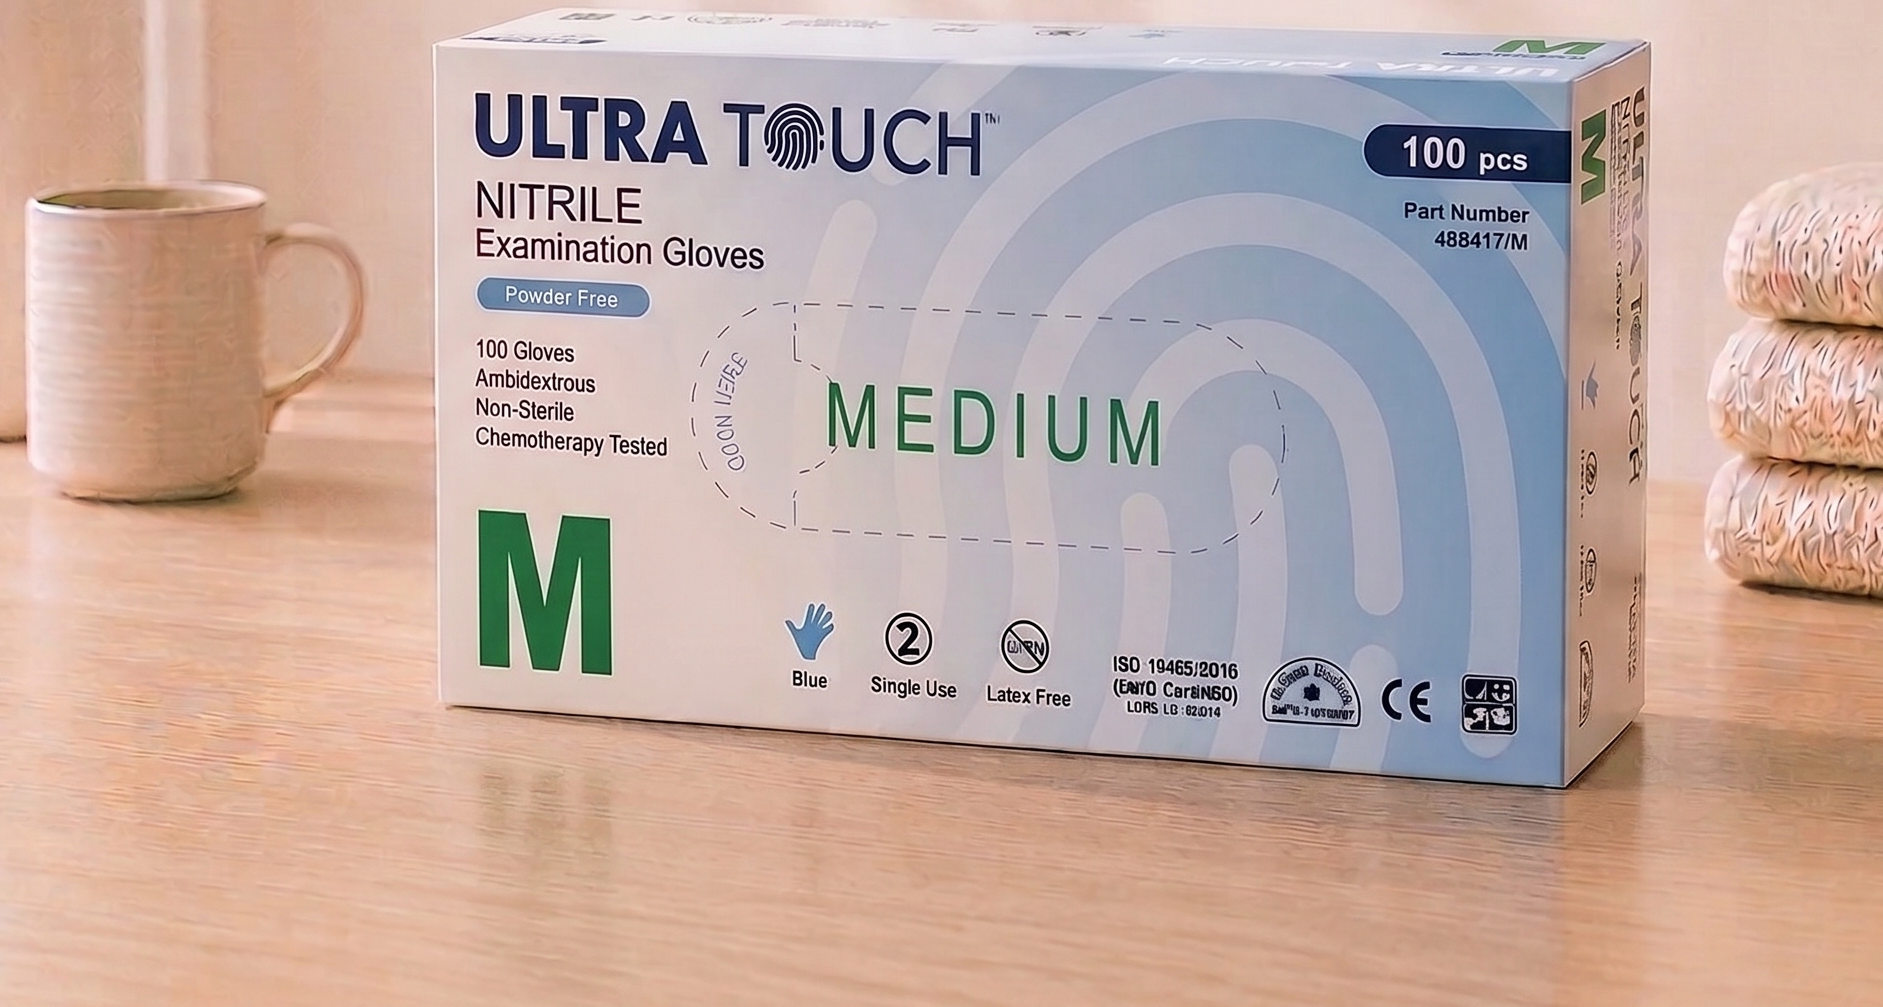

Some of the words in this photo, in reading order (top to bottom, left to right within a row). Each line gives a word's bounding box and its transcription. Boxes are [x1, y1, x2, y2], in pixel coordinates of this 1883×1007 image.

[475, 93, 708, 166] ULTRA
[723, 103, 981, 176] TOUCH
[1403, 136, 1466, 169] 100
[1479, 152, 1528, 175] pcs
[1581, 109, 1607, 205] M
[475, 181, 642, 224] NITRILE
[1404, 202, 1445, 220] Part
[1451, 203, 1530, 223] Number
[475, 228, 651, 265] Examination
[663, 236, 765, 270] Gloves
[1434, 231, 1528, 250] 488417/M
[505, 286, 574, 305] Powder
[578, 289, 618, 308] Free
[476, 339, 508, 359] 100
[514, 340, 575, 362] Gloves
[475, 369, 596, 393] Ambidextrous
[475, 398, 575, 421] Non-Sterile
[828, 382, 1159, 466] MEDIUM
[475, 427, 603, 456] Chemotherapy
[609, 434, 668, 456] Tested
[477, 509, 612, 676] M
[1113, 656, 1140, 673] ISO
[792, 671, 828, 689] Blue
[871, 676, 921, 699] Single
[926, 680, 957, 698] Use
[987, 686, 1031, 704] Latex
[1036, 689, 1072, 706] Free
[1381, 679, 1432, 723] CE
